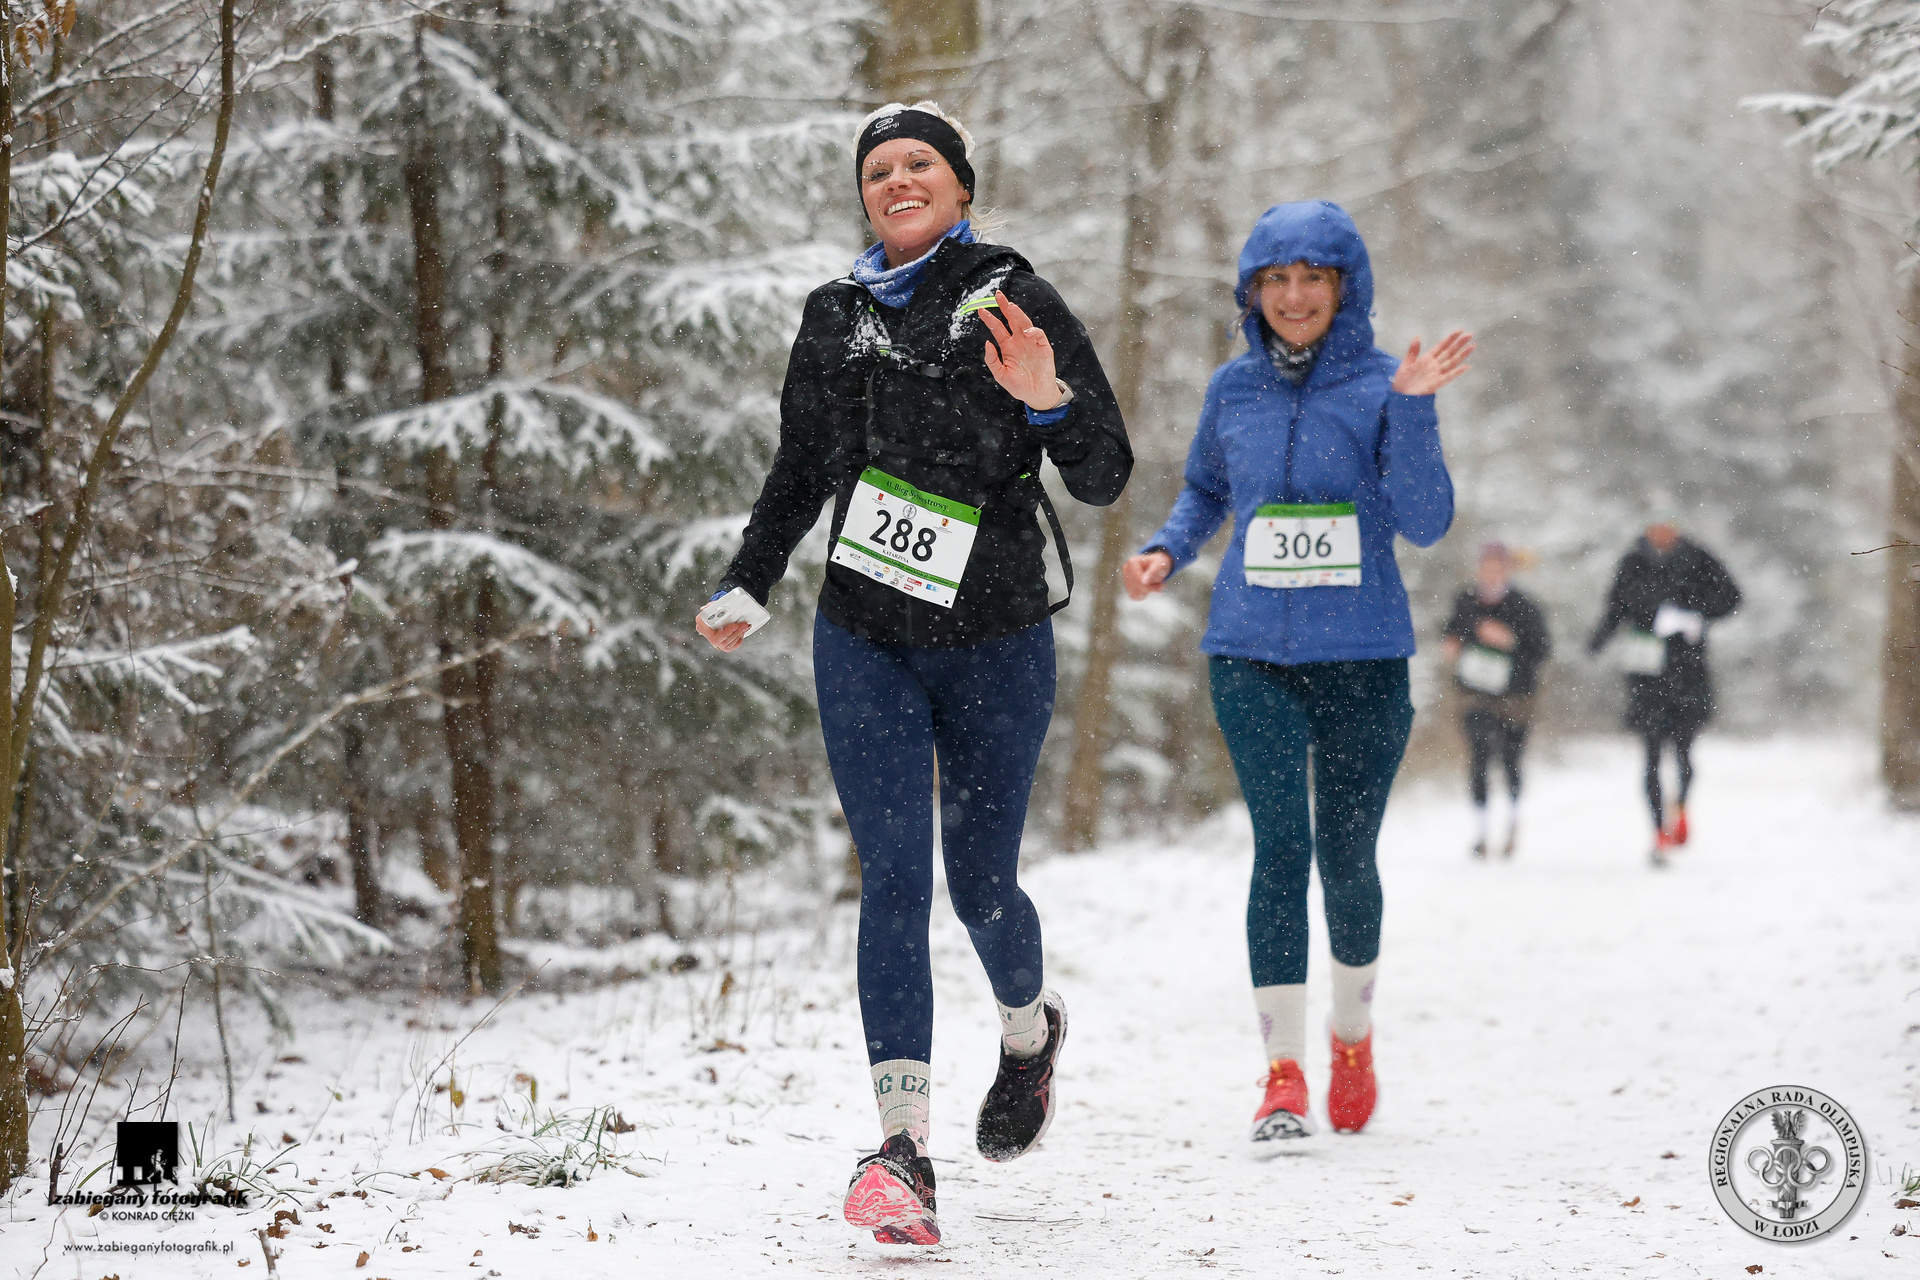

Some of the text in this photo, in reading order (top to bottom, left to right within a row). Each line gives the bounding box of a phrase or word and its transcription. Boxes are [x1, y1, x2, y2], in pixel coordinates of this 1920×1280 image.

[869, 509, 937, 562] 288
[1273, 531, 1332, 560] 306
[900, 1074, 930, 1099] CZ
